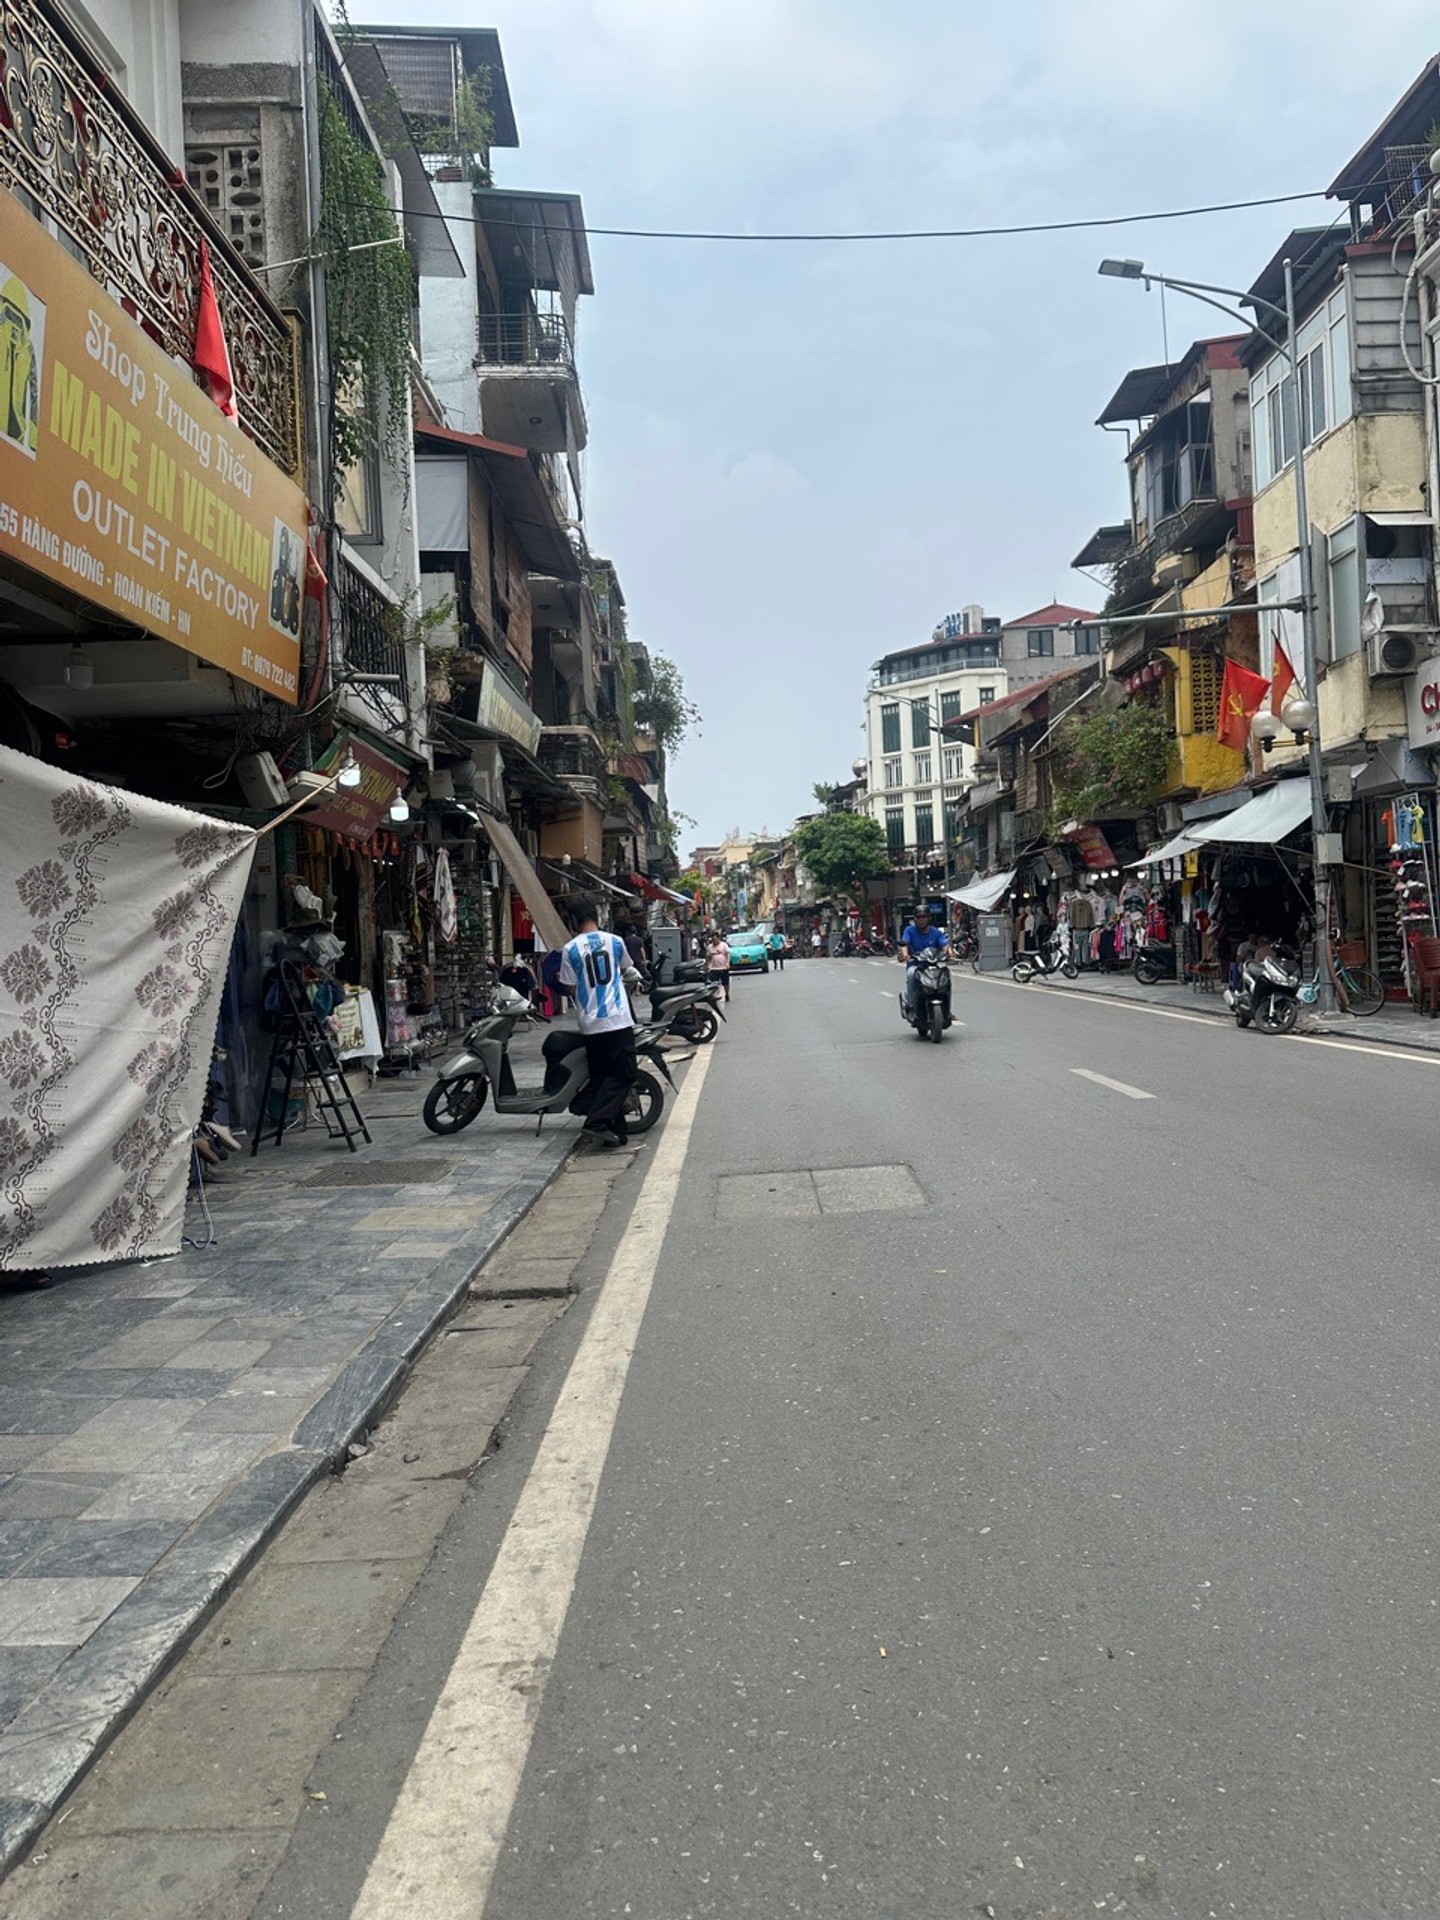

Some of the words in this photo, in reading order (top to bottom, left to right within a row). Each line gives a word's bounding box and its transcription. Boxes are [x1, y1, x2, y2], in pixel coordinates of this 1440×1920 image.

[85, 308, 146, 407] Shop
[153, 372, 212, 469] Trung
[49, 360, 141, 496] MADE
[147, 442, 177, 523] IN
[182, 469, 270, 592] VIETNAM
[22, 515, 60, 562] HÀNG
[62, 540, 105, 588] ĐƯỜNG
[113, 570, 144, 609] HOÀN
[72, 479, 171, 573] OUTLET
[174, 547, 260, 631] FACTORY
[584, 949, 612, 989] 10
